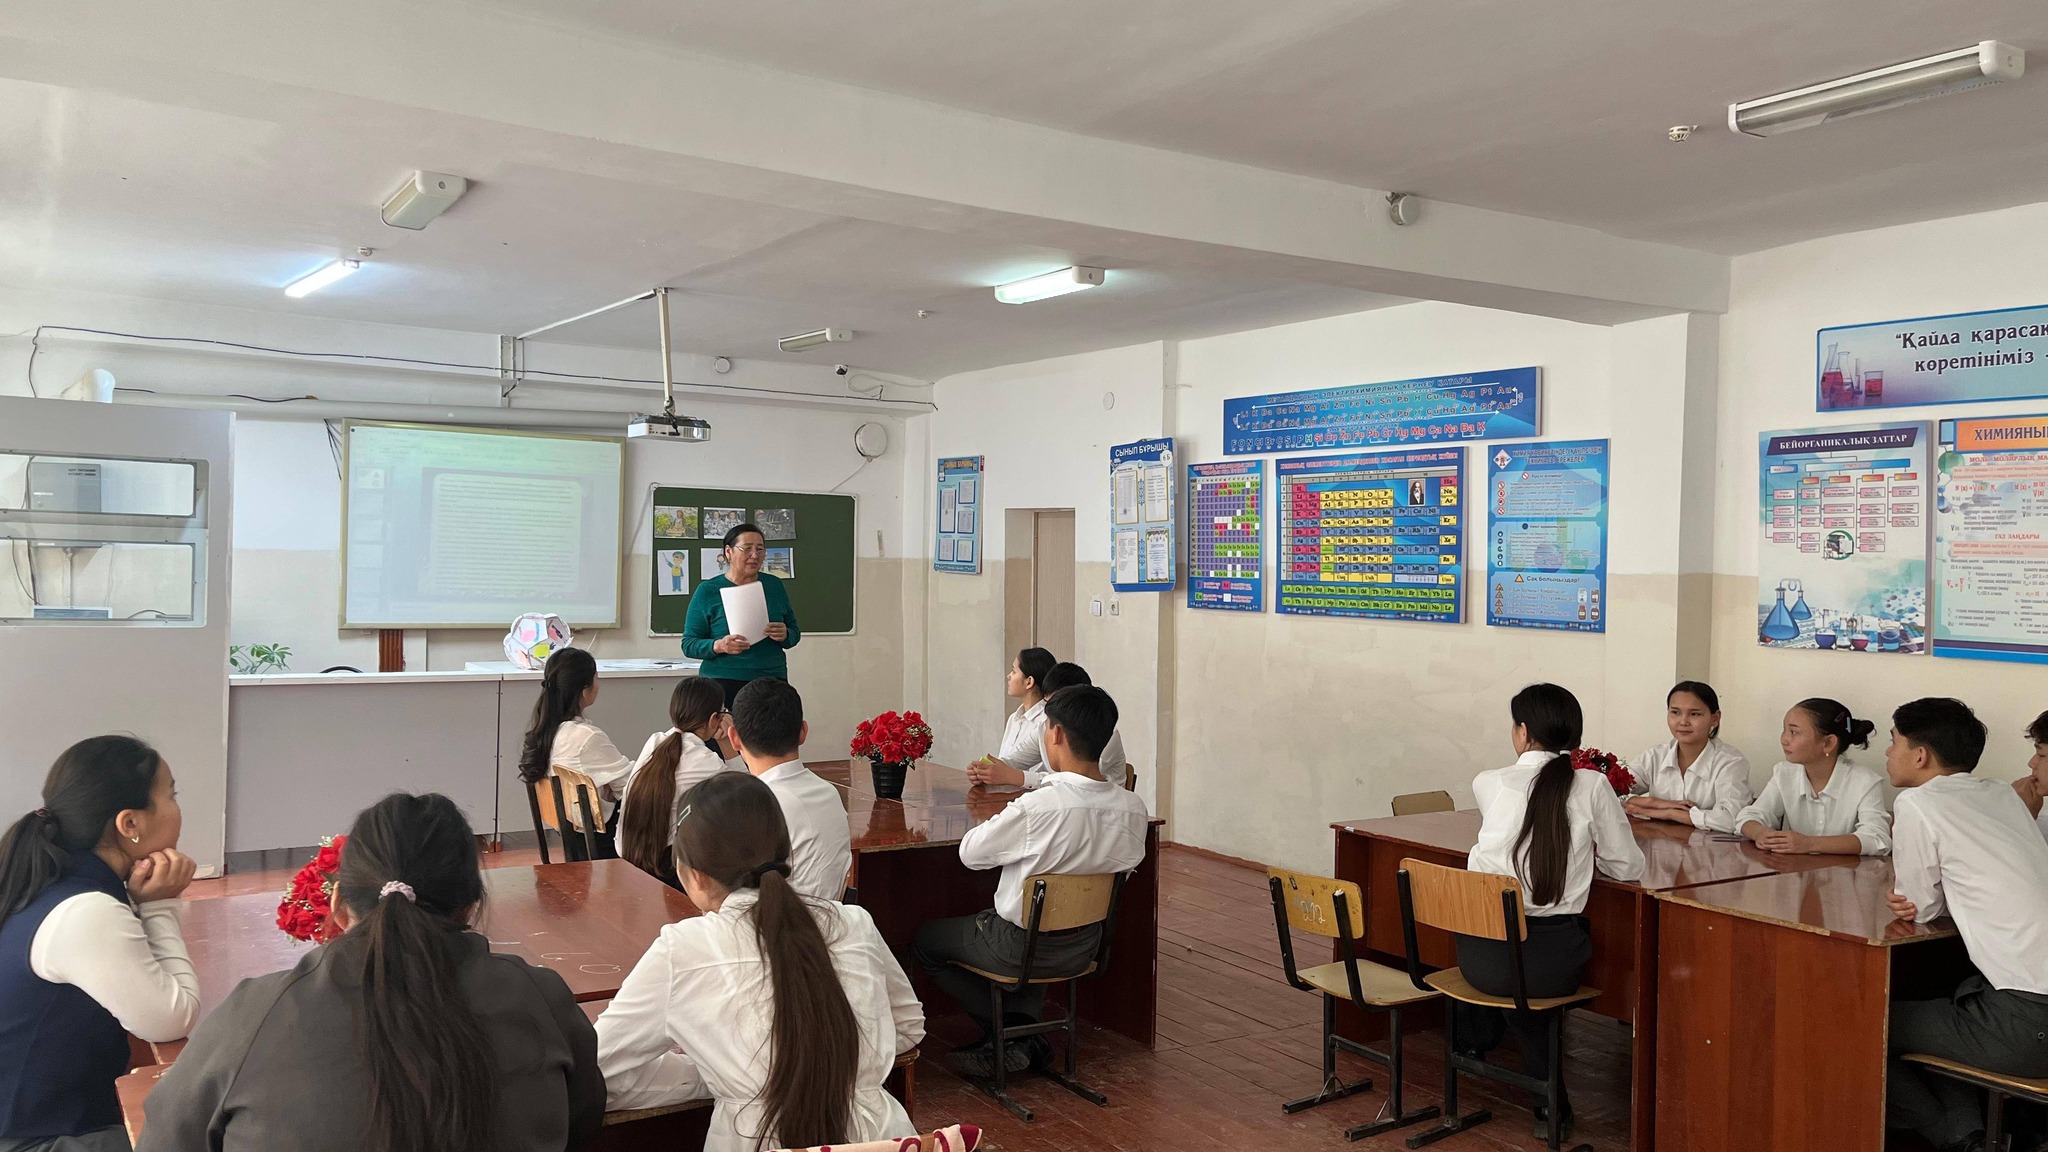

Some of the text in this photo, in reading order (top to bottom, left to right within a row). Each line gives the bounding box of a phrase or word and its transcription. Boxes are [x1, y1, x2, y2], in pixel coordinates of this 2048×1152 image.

[1896, 331, 1960, 350] “Қайда
[1915, 348, 2034, 375] көретініміз
[1872, 434, 1907, 444] ЗАТТАР
[1974, 426, 2048, 440] ХИМИЯНЫ
[1115, 446, 1138, 457] СЫНЫП
